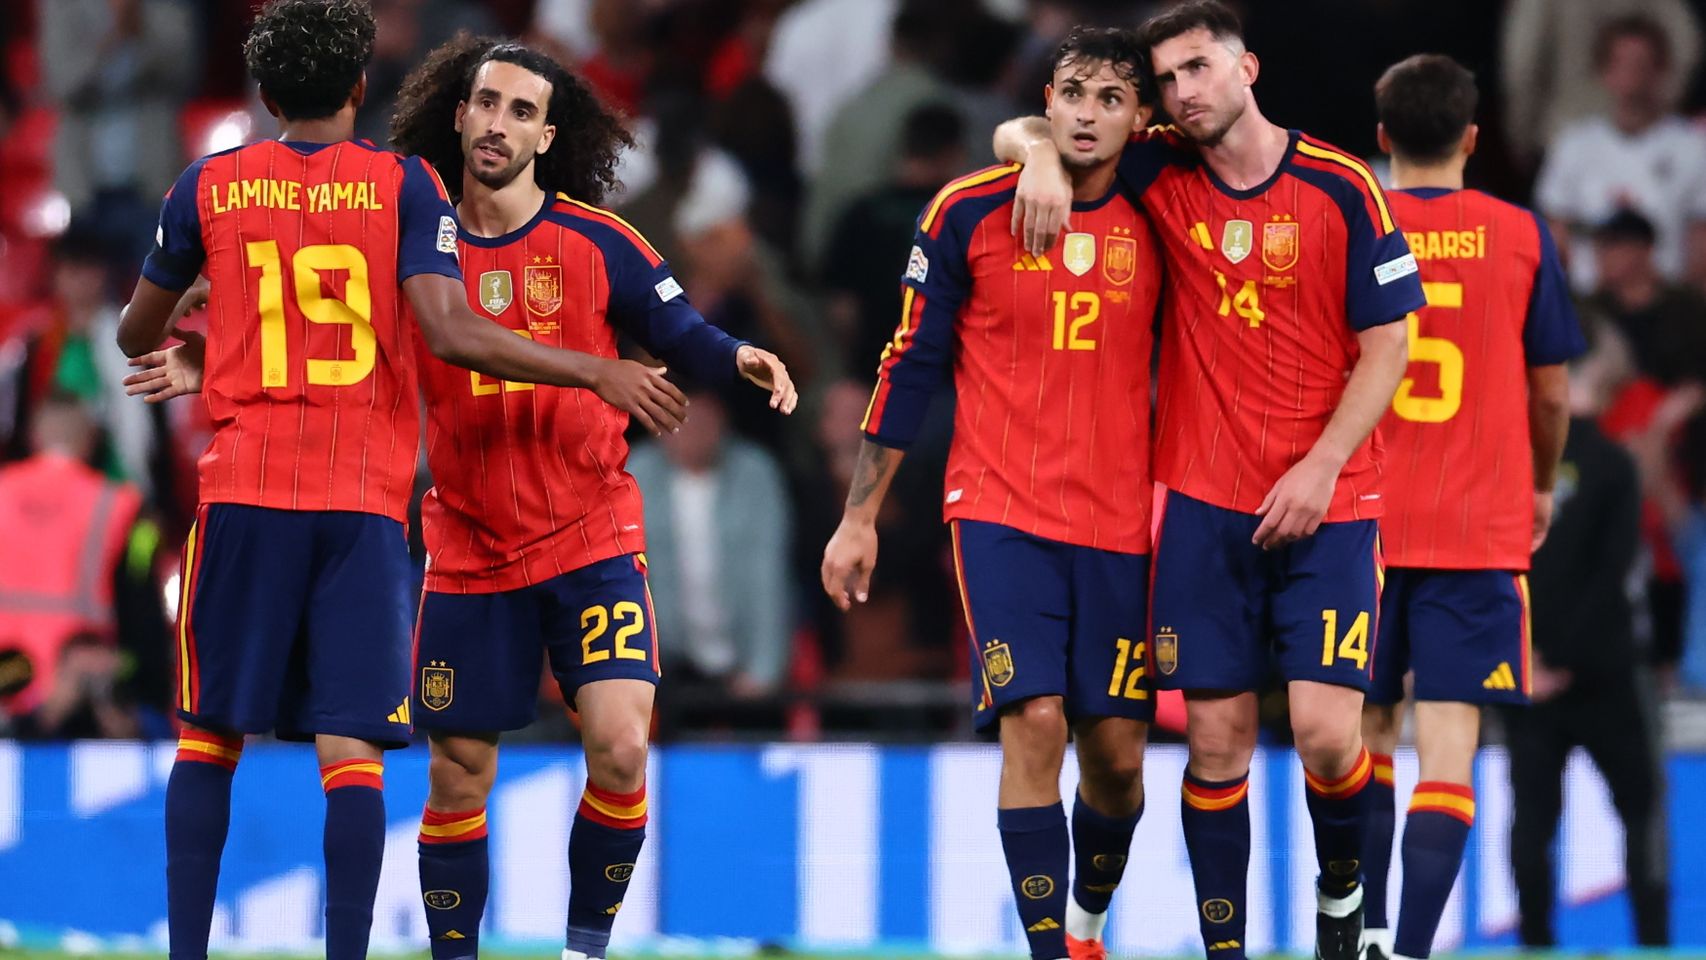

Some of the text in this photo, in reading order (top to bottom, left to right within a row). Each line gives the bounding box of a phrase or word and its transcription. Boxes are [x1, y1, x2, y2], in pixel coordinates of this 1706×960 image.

[212, 178, 383, 214] LAMINE YAMAL
[1402, 225, 1485, 260] BARSÍ
[246, 240, 377, 388] 19
[1052, 291, 1101, 350] 12
[1215, 269, 1265, 328] 14
[1392, 281, 1465, 423] 5
[580, 600, 647, 665] 22
[1321, 609, 1370, 670] 14
[1108, 637, 1149, 700] 12
